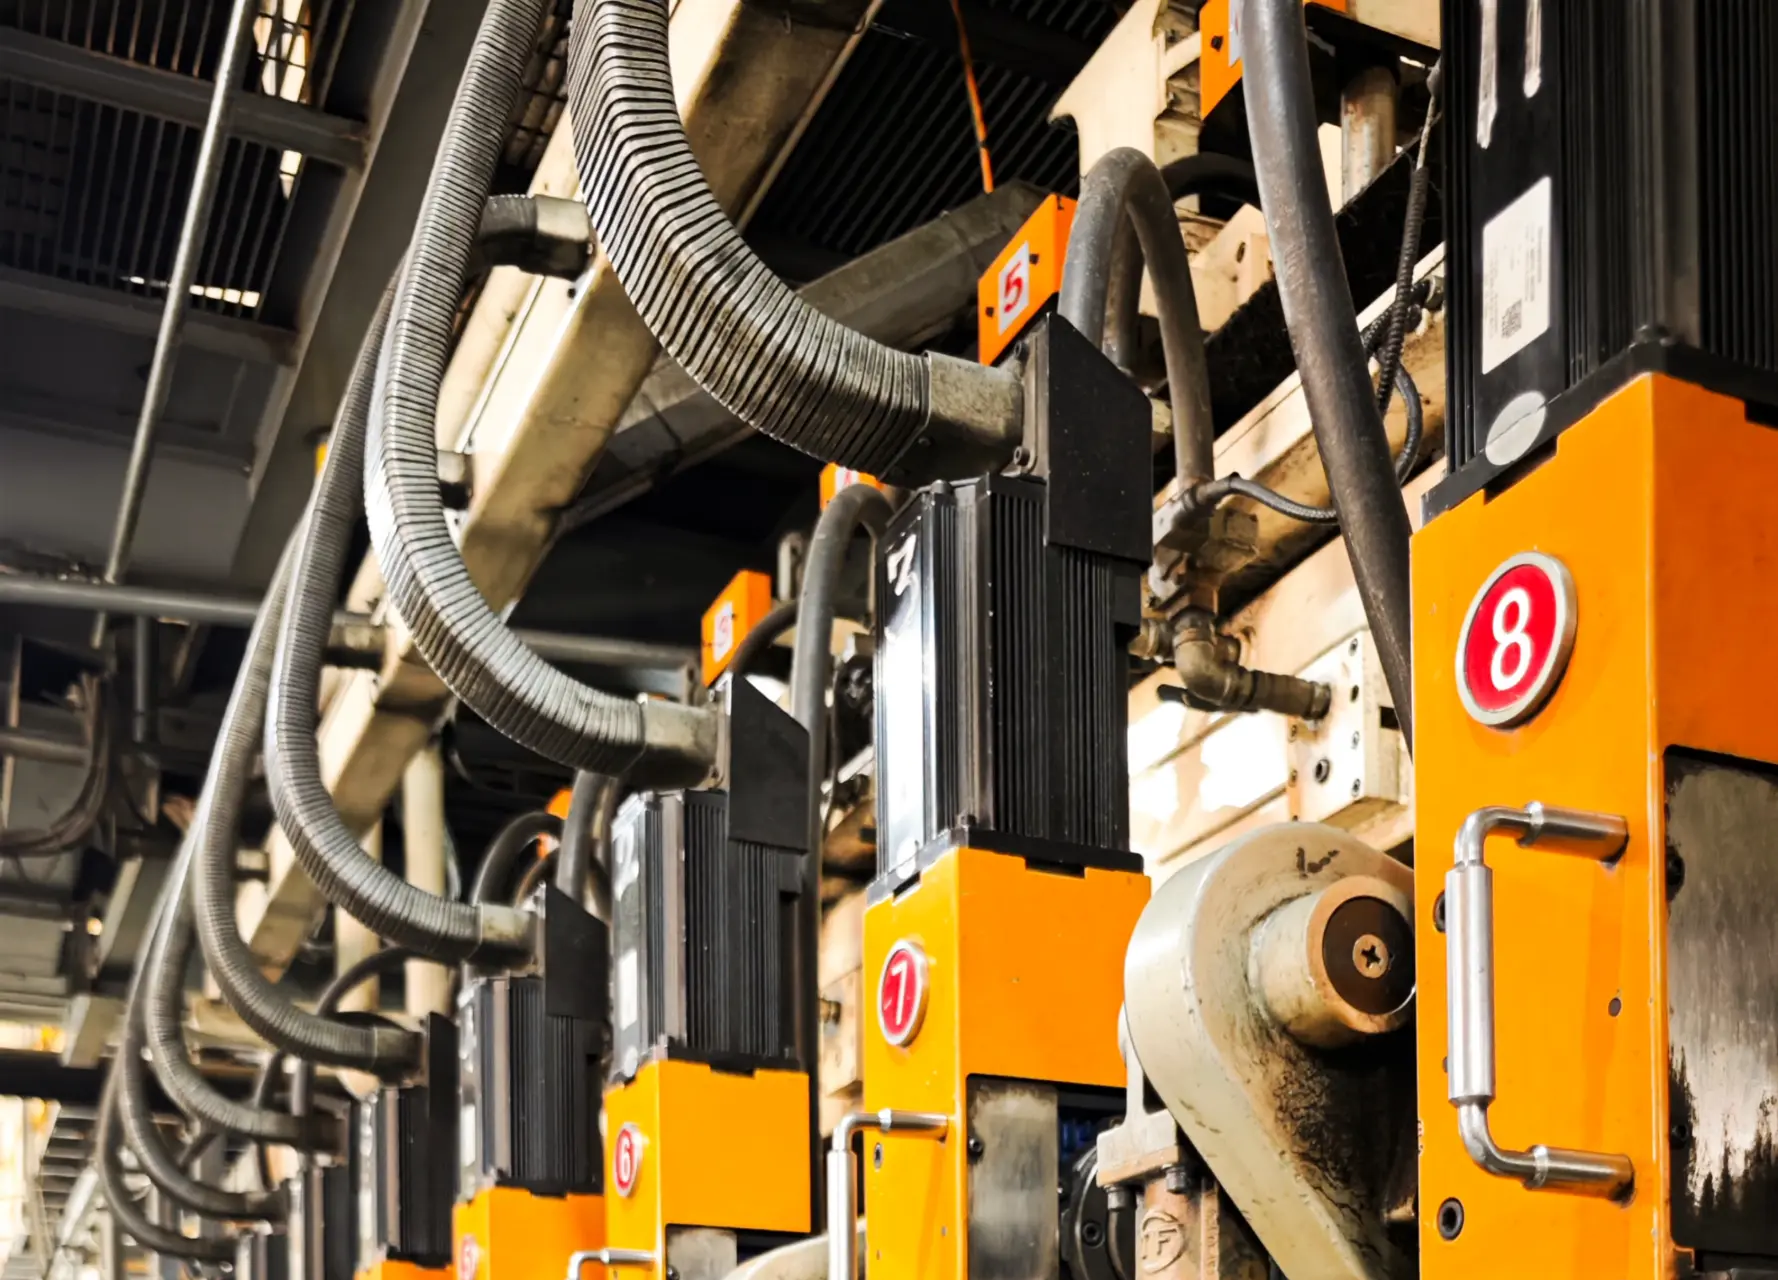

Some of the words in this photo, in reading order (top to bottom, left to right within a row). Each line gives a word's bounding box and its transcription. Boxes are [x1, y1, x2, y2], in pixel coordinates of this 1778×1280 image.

[1004, 260, 1024, 313] 5
[1491, 587, 1532, 692] 8
[891, 960, 908, 1026] 7
[620, 1135, 631, 1183] 6
